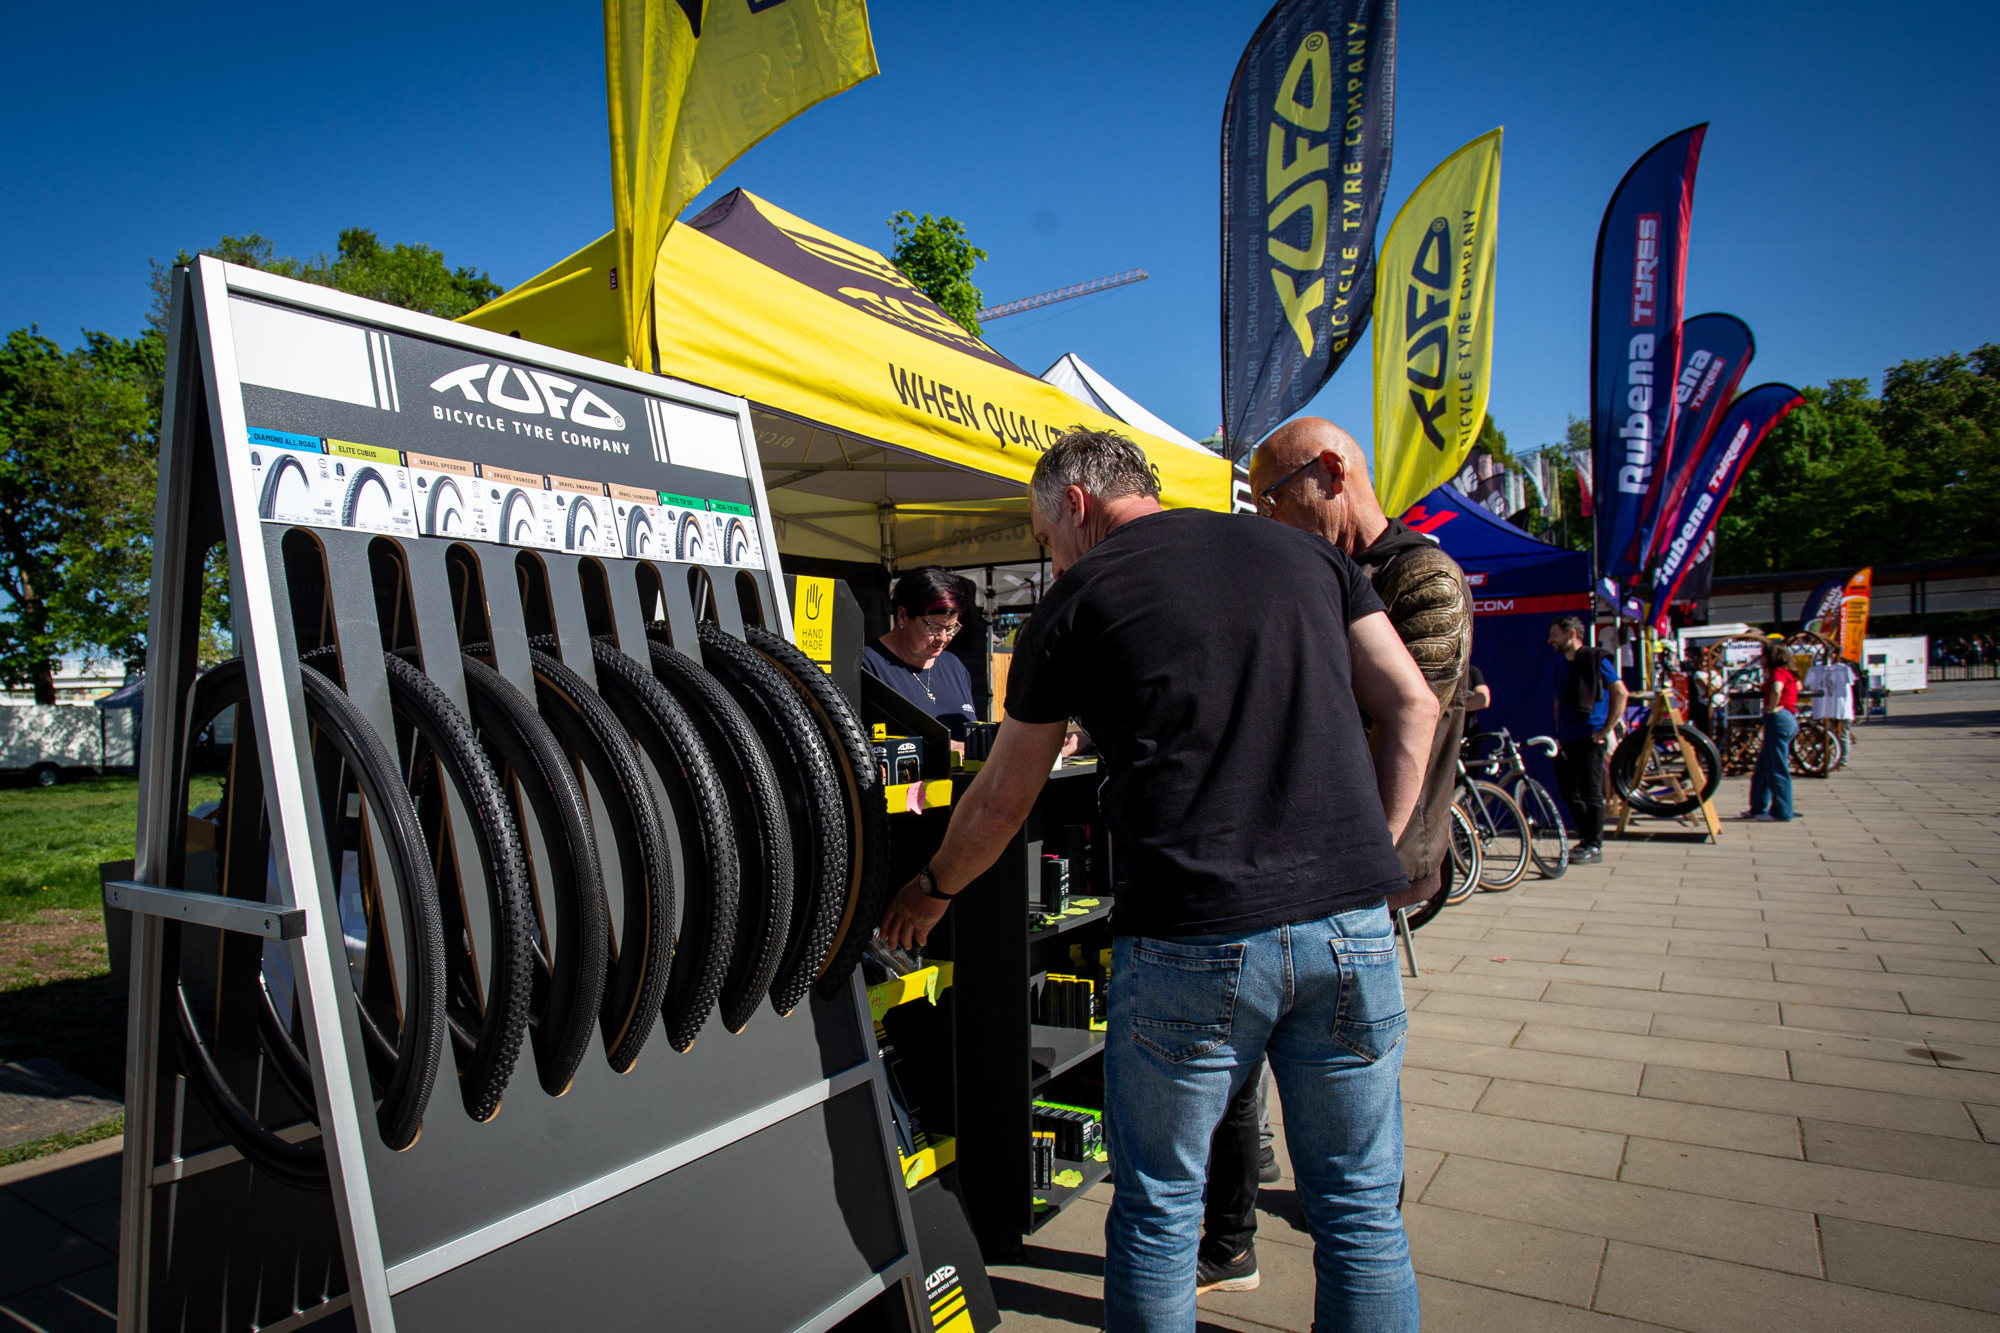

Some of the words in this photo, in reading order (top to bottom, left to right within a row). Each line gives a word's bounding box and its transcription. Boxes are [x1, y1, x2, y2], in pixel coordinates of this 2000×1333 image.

[1345, 23, 1367, 146] COMPANY
[1248, 93, 1260, 156] TUBOLARE
[1248, 175, 1260, 217] BOYAU
[1266, 31, 1332, 358] TUFO
[1343, 162, 1363, 232] TYRE
[1460, 209, 1476, 300] COMPANY
[1634, 219, 1659, 322] TYRES
[1248, 234, 1260, 342] SCHLAUCHREIFEN
[1331, 247, 1358, 352] BICYCLE
[1406, 217, 1452, 451] TUFO
[1458, 312, 1472, 361] TYRE
[430, 363, 626, 431] TUFO
[889, 362, 981, 431] WHEN
[1618, 333, 1655, 494] Rubena
[1690, 359, 1723, 409] TYRES
[253, 432, 284, 444] DIAMOND
[284, 438, 298, 447] ALL
[298, 440, 317, 449] ROAD
[338, 445, 356, 455] ELITE
[357, 448, 377, 458] CUBUS
[433, 405, 505, 432] BICYCLE
[512, 421, 554, 441] TYRE
[561, 431, 630, 456] COMPANY
[1709, 423, 1750, 488] TYRES
[420, 459, 440, 468] GRAVEL
[493, 472, 512, 481] GRAVEL
[558, 481, 574, 489] GRAVEL
[802, 628, 823, 639] HAND
[802, 640, 823, 650] MADE
